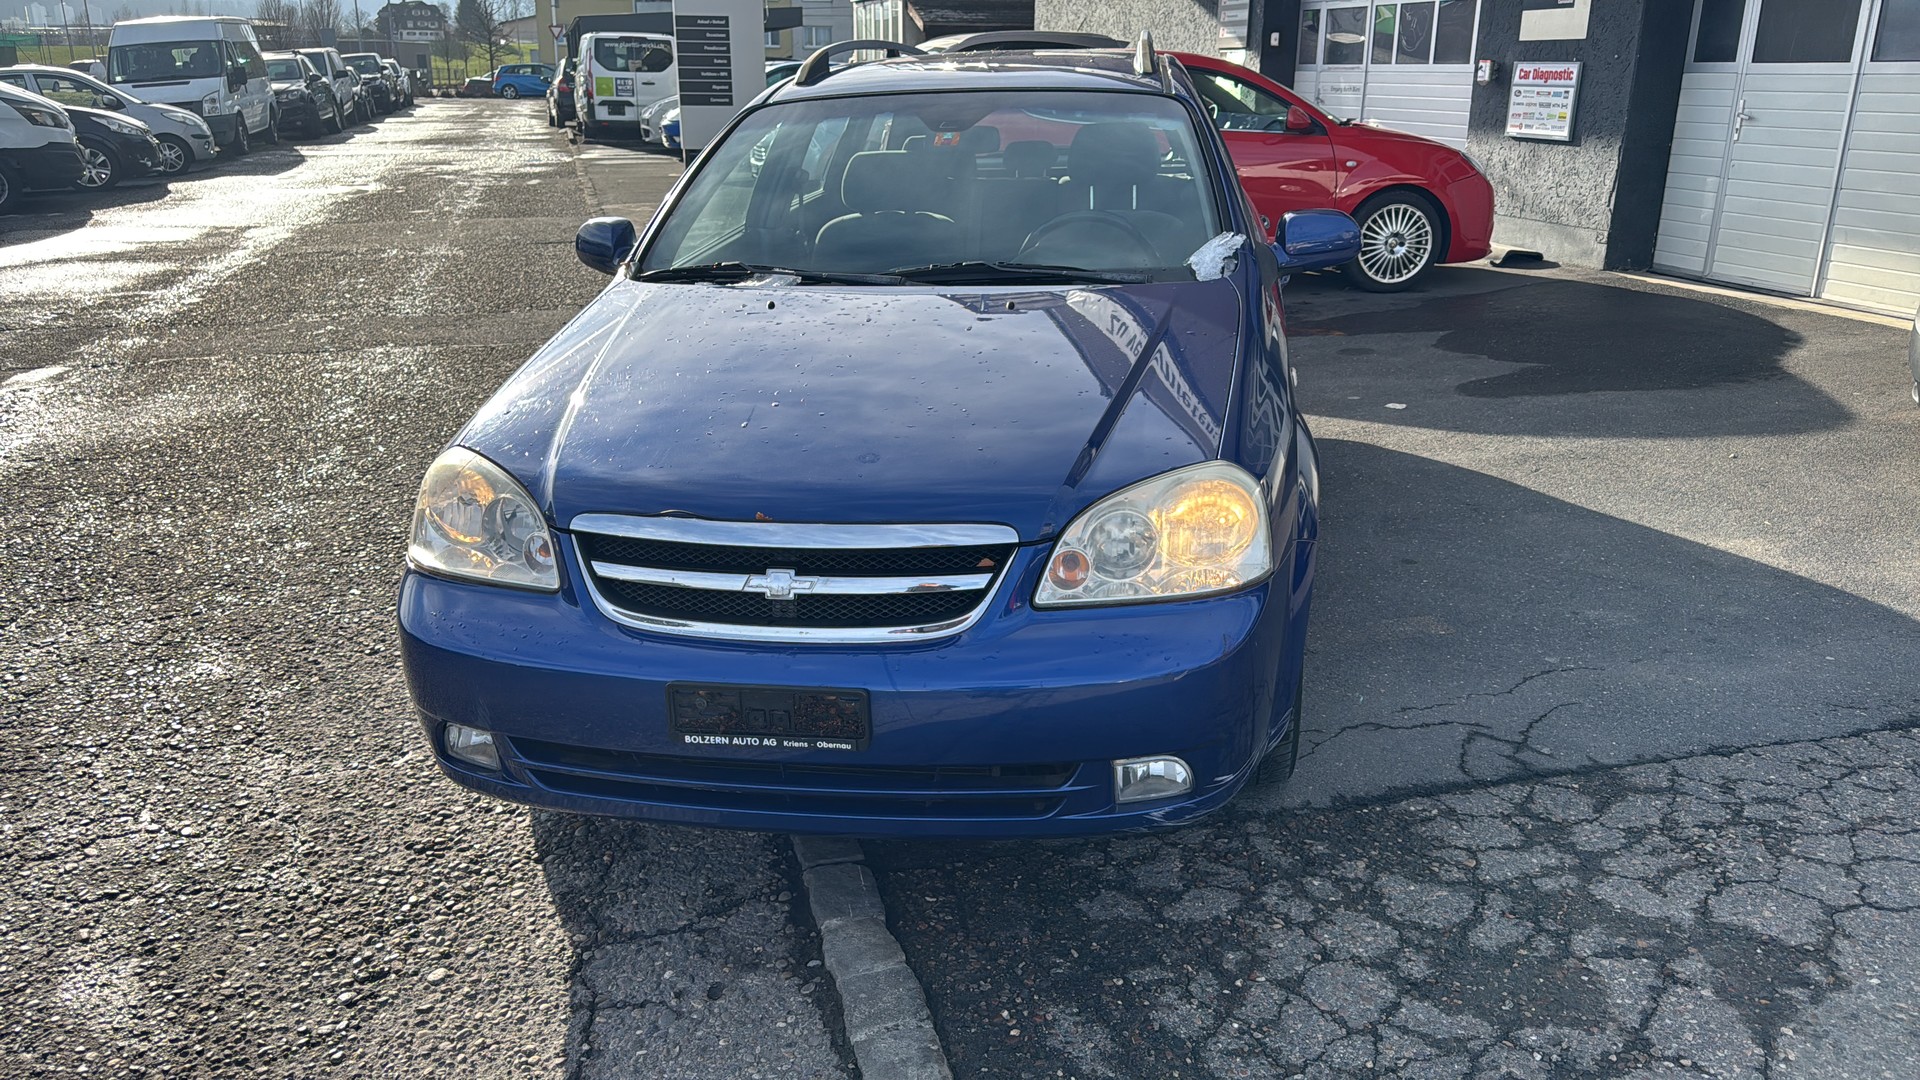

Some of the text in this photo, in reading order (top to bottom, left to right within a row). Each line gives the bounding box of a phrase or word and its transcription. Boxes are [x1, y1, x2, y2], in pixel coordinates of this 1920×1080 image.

[1518, 67, 1574, 83] Car Diagnostic
[684, 735, 729, 745] BOLZERN
[732, 736, 760, 746] AUTO
[762, 737, 777, 746] AG
[783, 740, 808, 748] Kriens
[816, 741, 852, 750] Obernau
